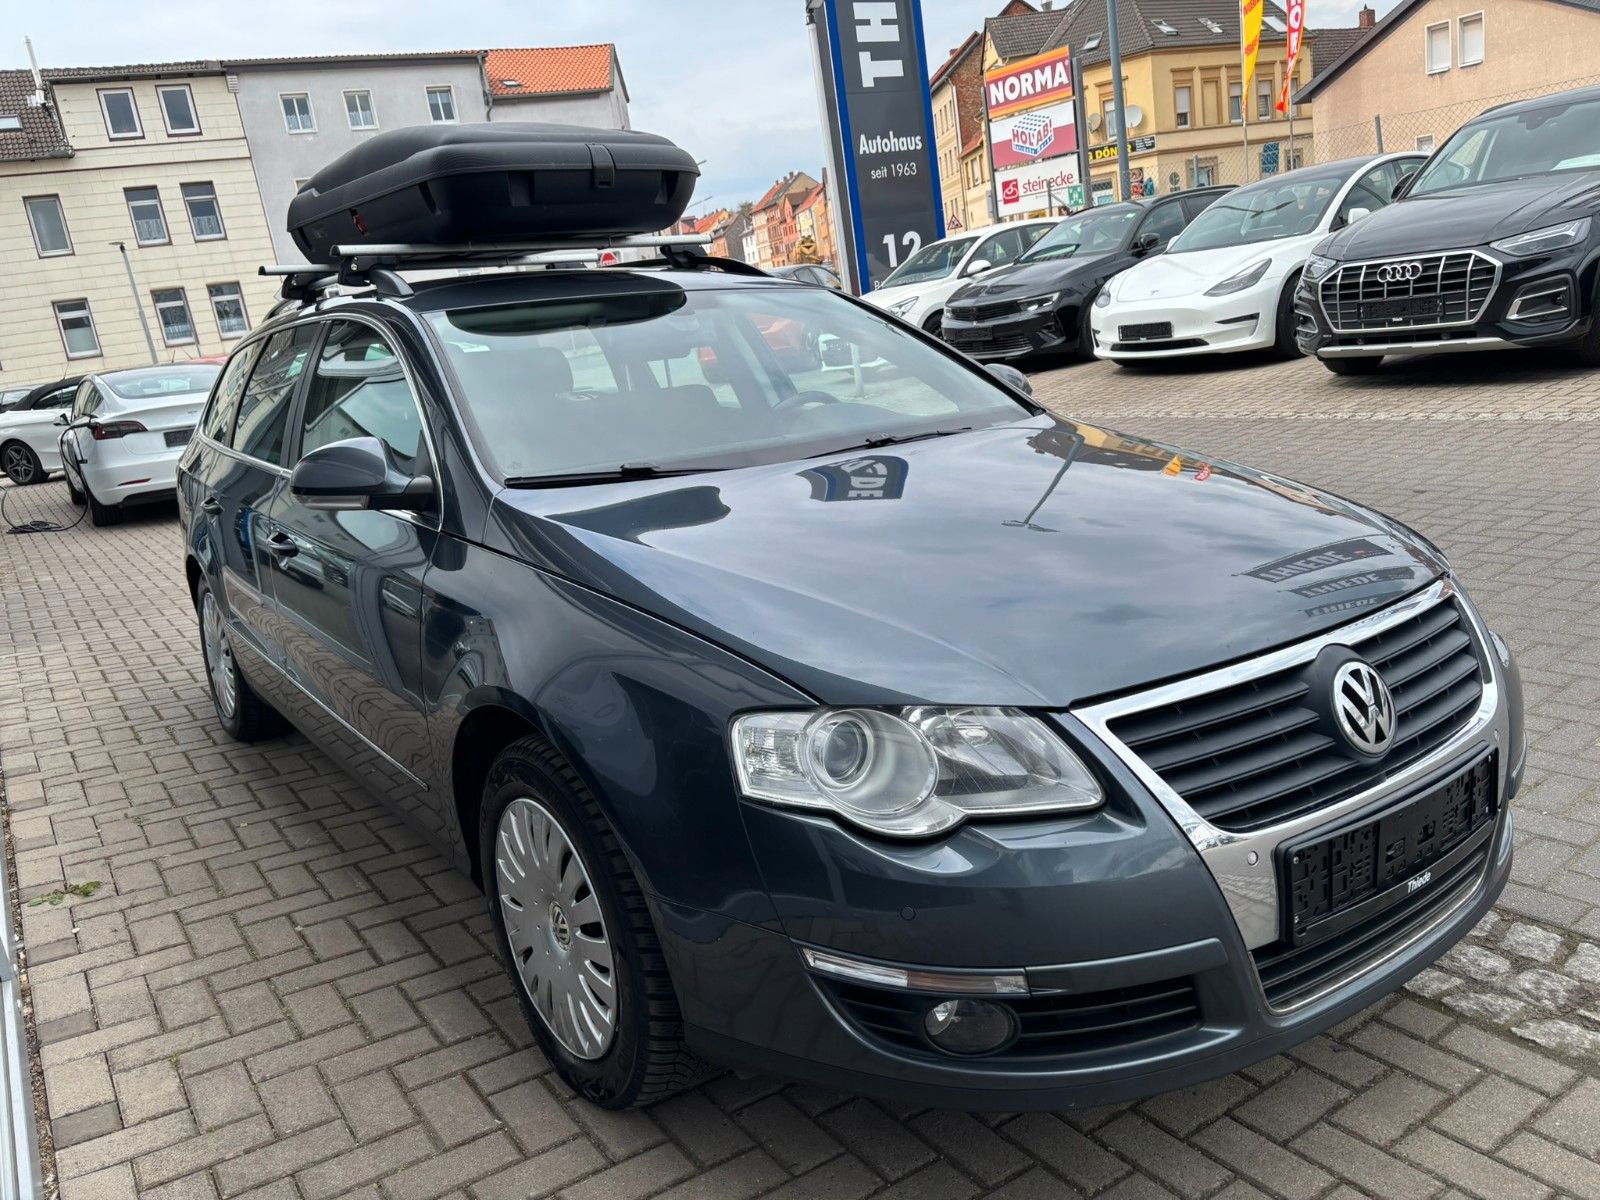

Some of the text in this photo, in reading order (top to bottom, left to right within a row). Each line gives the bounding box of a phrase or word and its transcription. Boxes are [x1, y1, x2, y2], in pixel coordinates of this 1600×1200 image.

[989, 61, 1069, 106] NORMA
[859, 131, 922, 155] Autohaus
[1095, 143, 1132, 159] DÖNR
[870, 162, 917, 179] seit 1963
[1022, 170, 1074, 194] steinecke
[1407, 871, 1431, 894] Thiede
